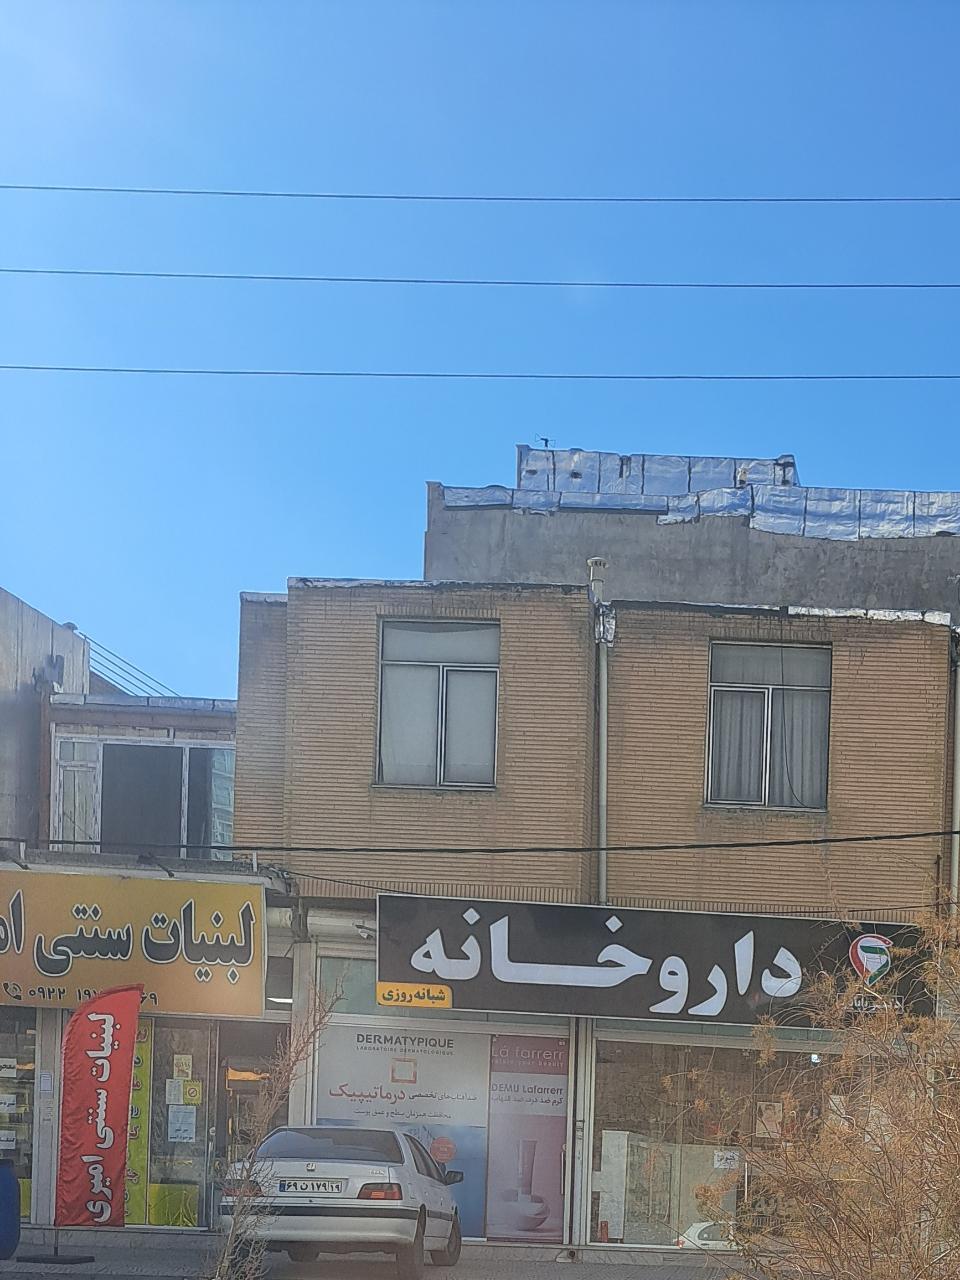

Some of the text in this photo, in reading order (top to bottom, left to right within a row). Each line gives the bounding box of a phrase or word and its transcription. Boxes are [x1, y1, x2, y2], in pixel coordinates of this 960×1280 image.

[0, 888, 256, 985] لبنیات سنتی ام
[409, 906, 803, 1018] داروخانه
[356, 1033, 455, 1049] DERMATYPIQUE
[80, 1012, 121, 1225] لبنیات سنتی امیری
[329, 1083, 406, 1105] درماتیپیک
[310, 1181, 328, 1192] ۱۷۹
